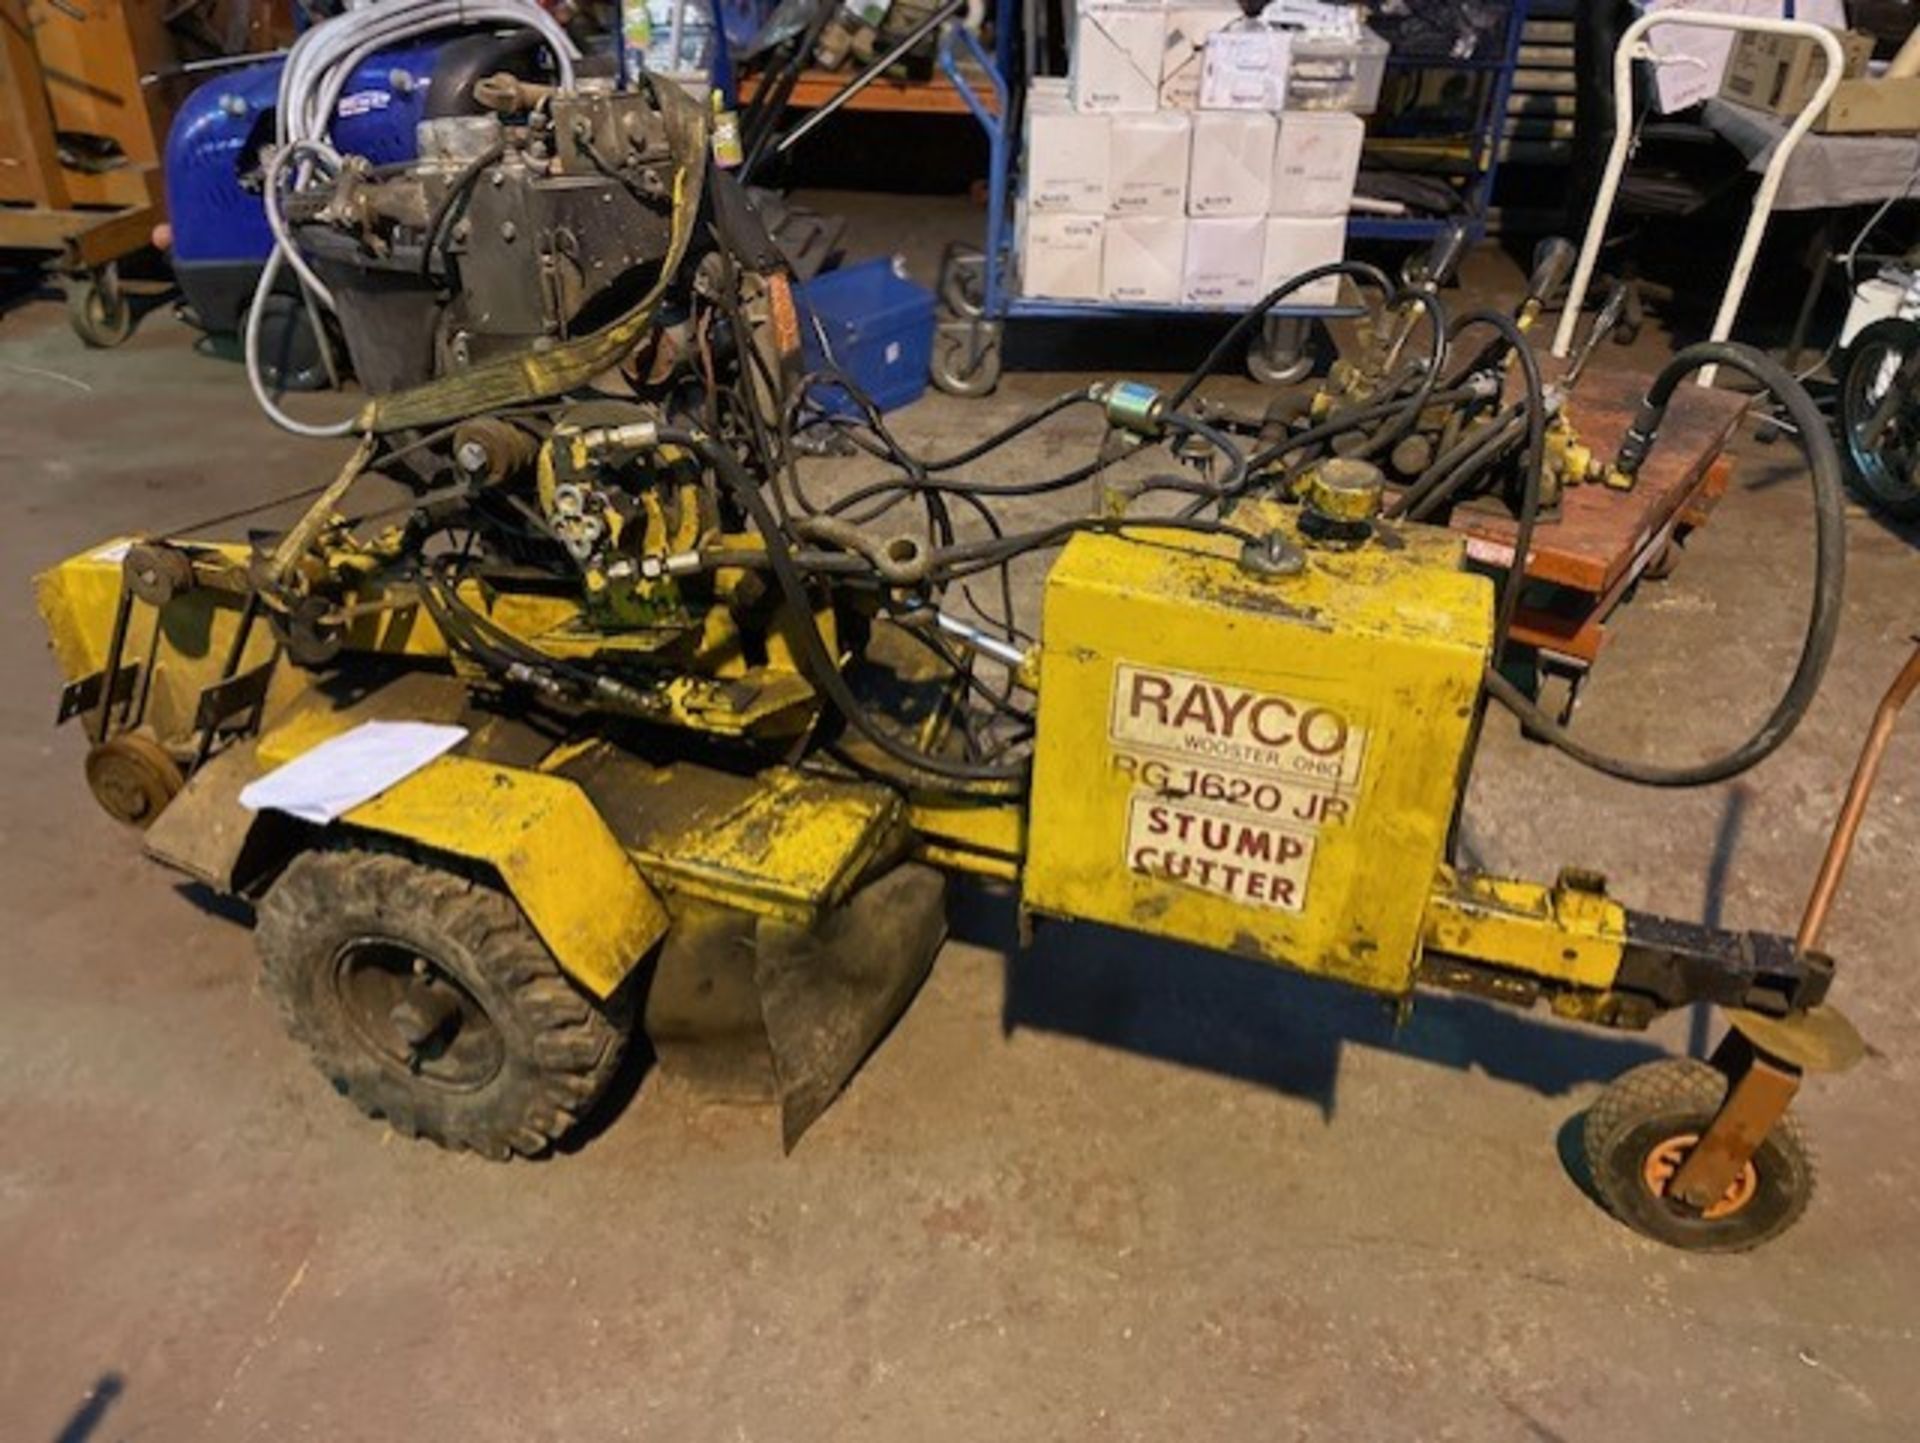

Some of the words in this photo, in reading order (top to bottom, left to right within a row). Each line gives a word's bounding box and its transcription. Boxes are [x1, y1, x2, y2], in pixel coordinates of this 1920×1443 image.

[1130, 672, 1348, 757] RAYCO
[1182, 769, 1282, 813] 1620
[1292, 794, 1350, 826] JR
[1148, 806, 1303, 866] STUMP
[1133, 847, 1296, 905] CUTTER
